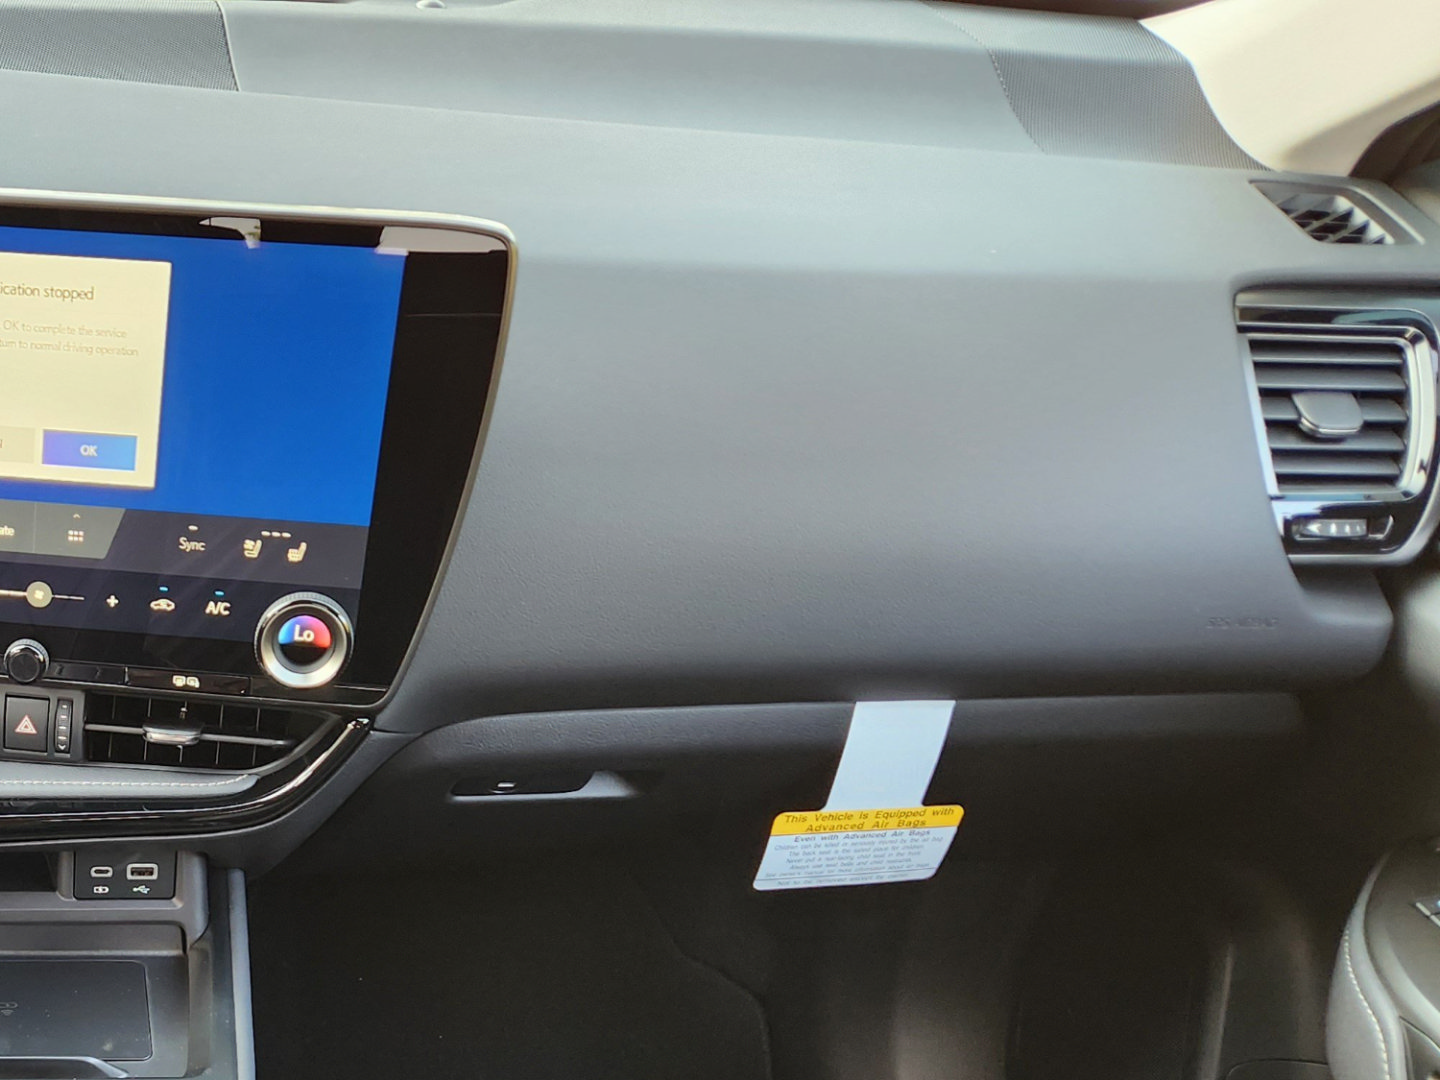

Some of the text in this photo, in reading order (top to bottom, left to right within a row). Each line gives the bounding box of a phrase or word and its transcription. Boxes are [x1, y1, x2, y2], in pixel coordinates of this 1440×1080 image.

[43, 286, 95, 303] stopped
[3, 319, 19, 331] OK
[21, 322, 32, 333] to
[33, 322, 76, 337] complete
[78, 324, 93, 336] the
[95, 326, 128, 338] service
[18, 340, 28, 349] to
[29, 339, 62, 351] normal
[63, 341, 94, 356] driving
[80, 444, 98, 457] OK
[178, 536, 206, 553] Sync
[205, 600, 231, 616] A/C
[293, 623, 315, 642] Lo
[785, 815, 808, 824] This
[814, 812, 854, 822] Vehicle
[875, 808, 927, 820] Equipped
[932, 807, 955, 816] with
[805, 818, 927, 832] Advanced Air Bags
[794, 835, 816, 843] Even
[820, 833, 839, 841] with
[843, 831, 887, 840] Advanced
